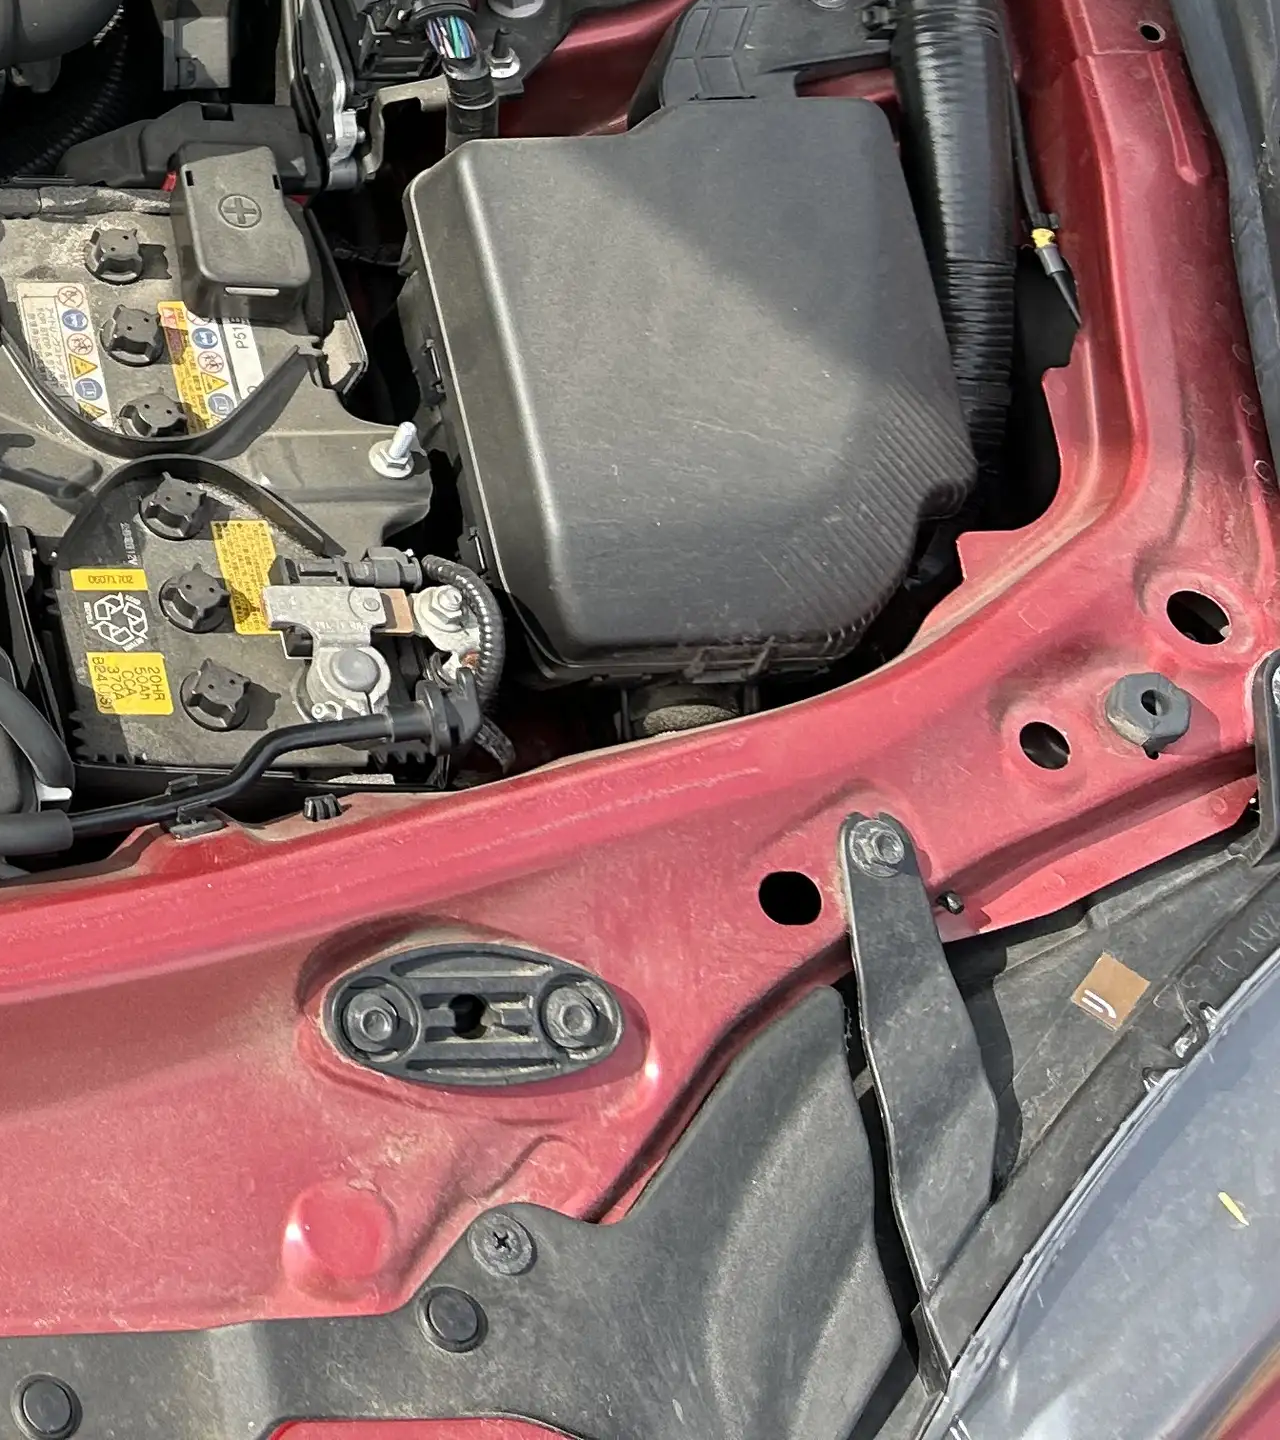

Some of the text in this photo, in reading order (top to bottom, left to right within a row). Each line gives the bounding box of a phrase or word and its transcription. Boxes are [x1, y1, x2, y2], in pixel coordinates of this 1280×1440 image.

[107, 666, 125, 700] 370A
[121, 670, 138, 696] CCA
[134, 667, 150, 700] 50Ah
[147, 666, 165, 701] 20HR
